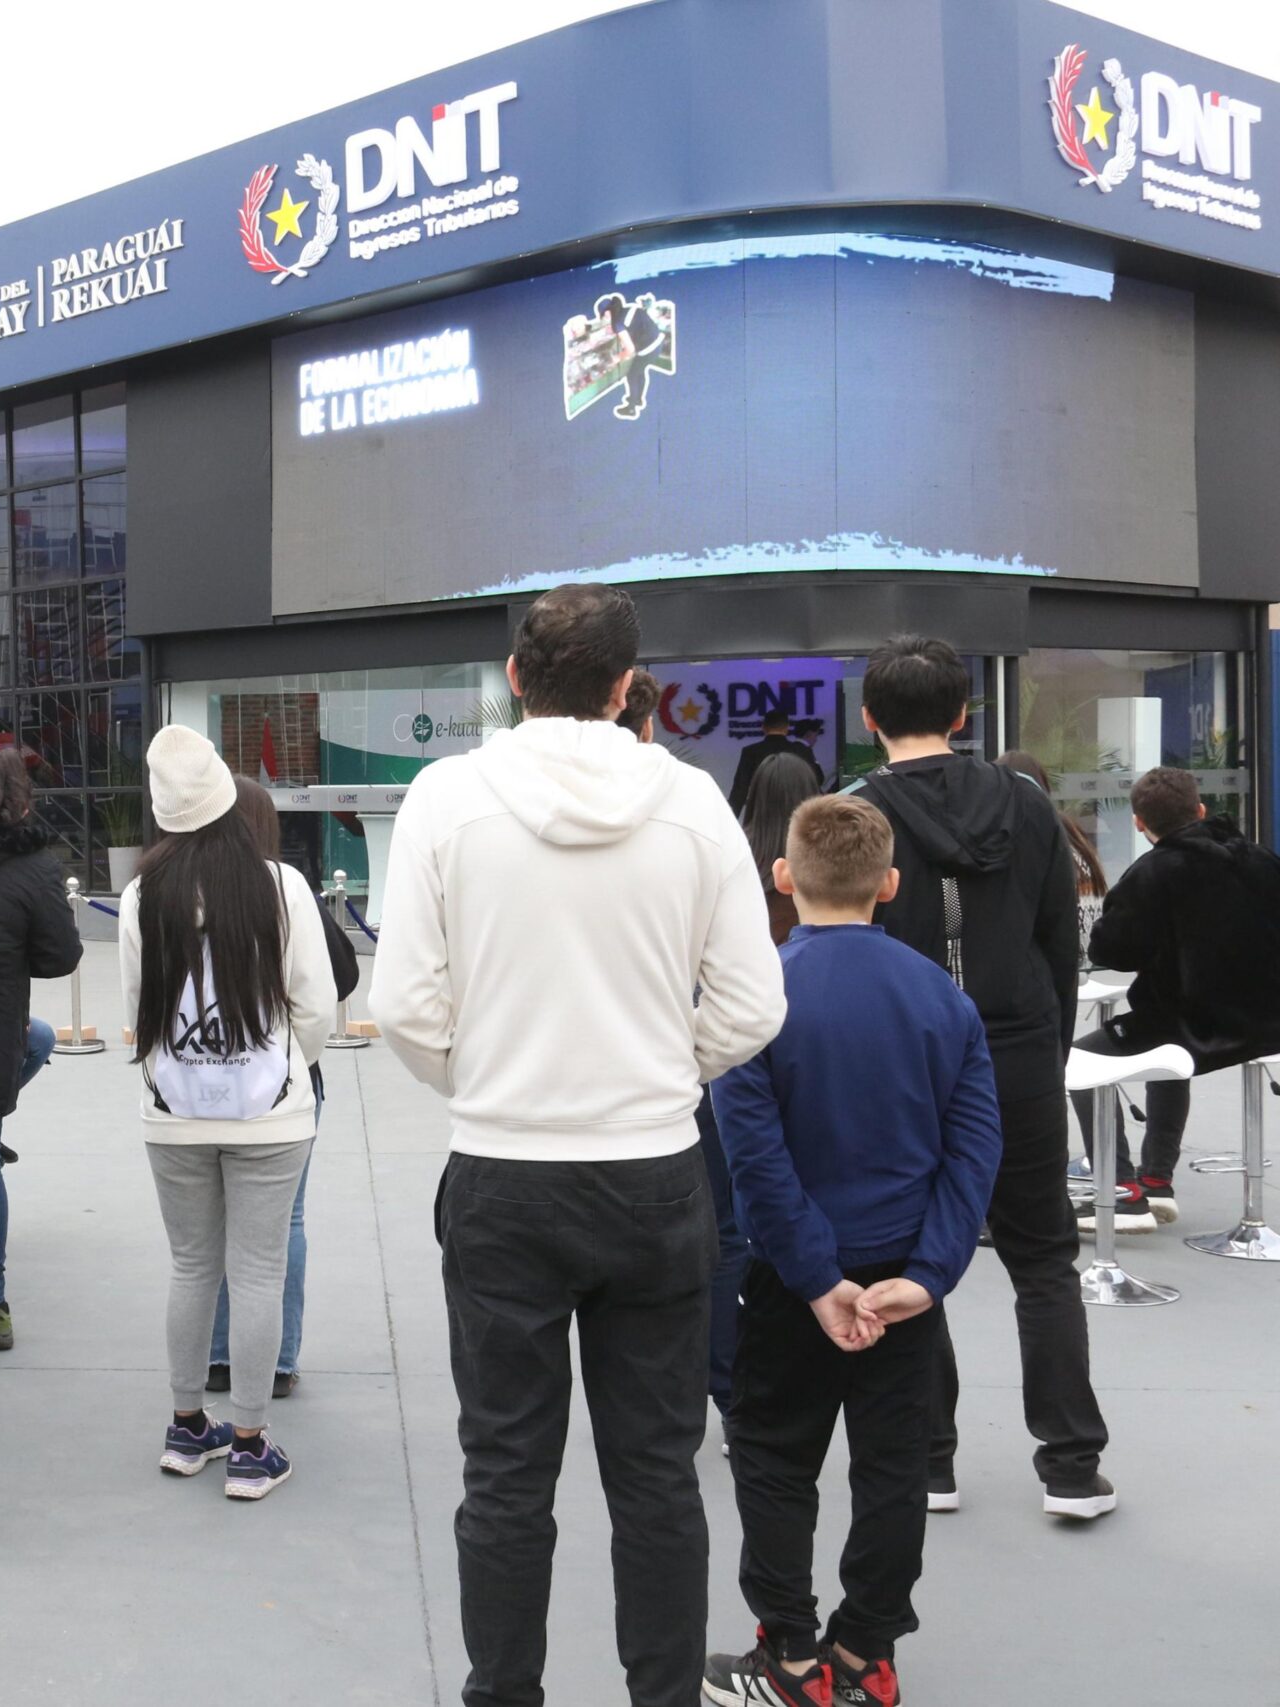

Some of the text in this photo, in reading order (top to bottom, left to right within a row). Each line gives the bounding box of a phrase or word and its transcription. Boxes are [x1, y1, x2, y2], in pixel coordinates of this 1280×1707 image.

[345, 81, 517, 213] DNIT
[1141, 71, 1262, 181] DNIT
[422, 179, 493, 217] Nacional
[494, 175, 519, 196] de
[51, 218, 185, 286] PARAGUÁI
[349, 199, 519, 260] Ingresos Tributarios
[0, 279, 30, 302] DEL
[51, 258, 168, 323] REKUÁI
[300, 329, 471, 399] FORMALIZACIÓN
[300, 366, 480, 436] DE LA ECONOMÍA
[728, 680, 824, 717] DNIT
[206, 1056, 251, 1066] Exchange
